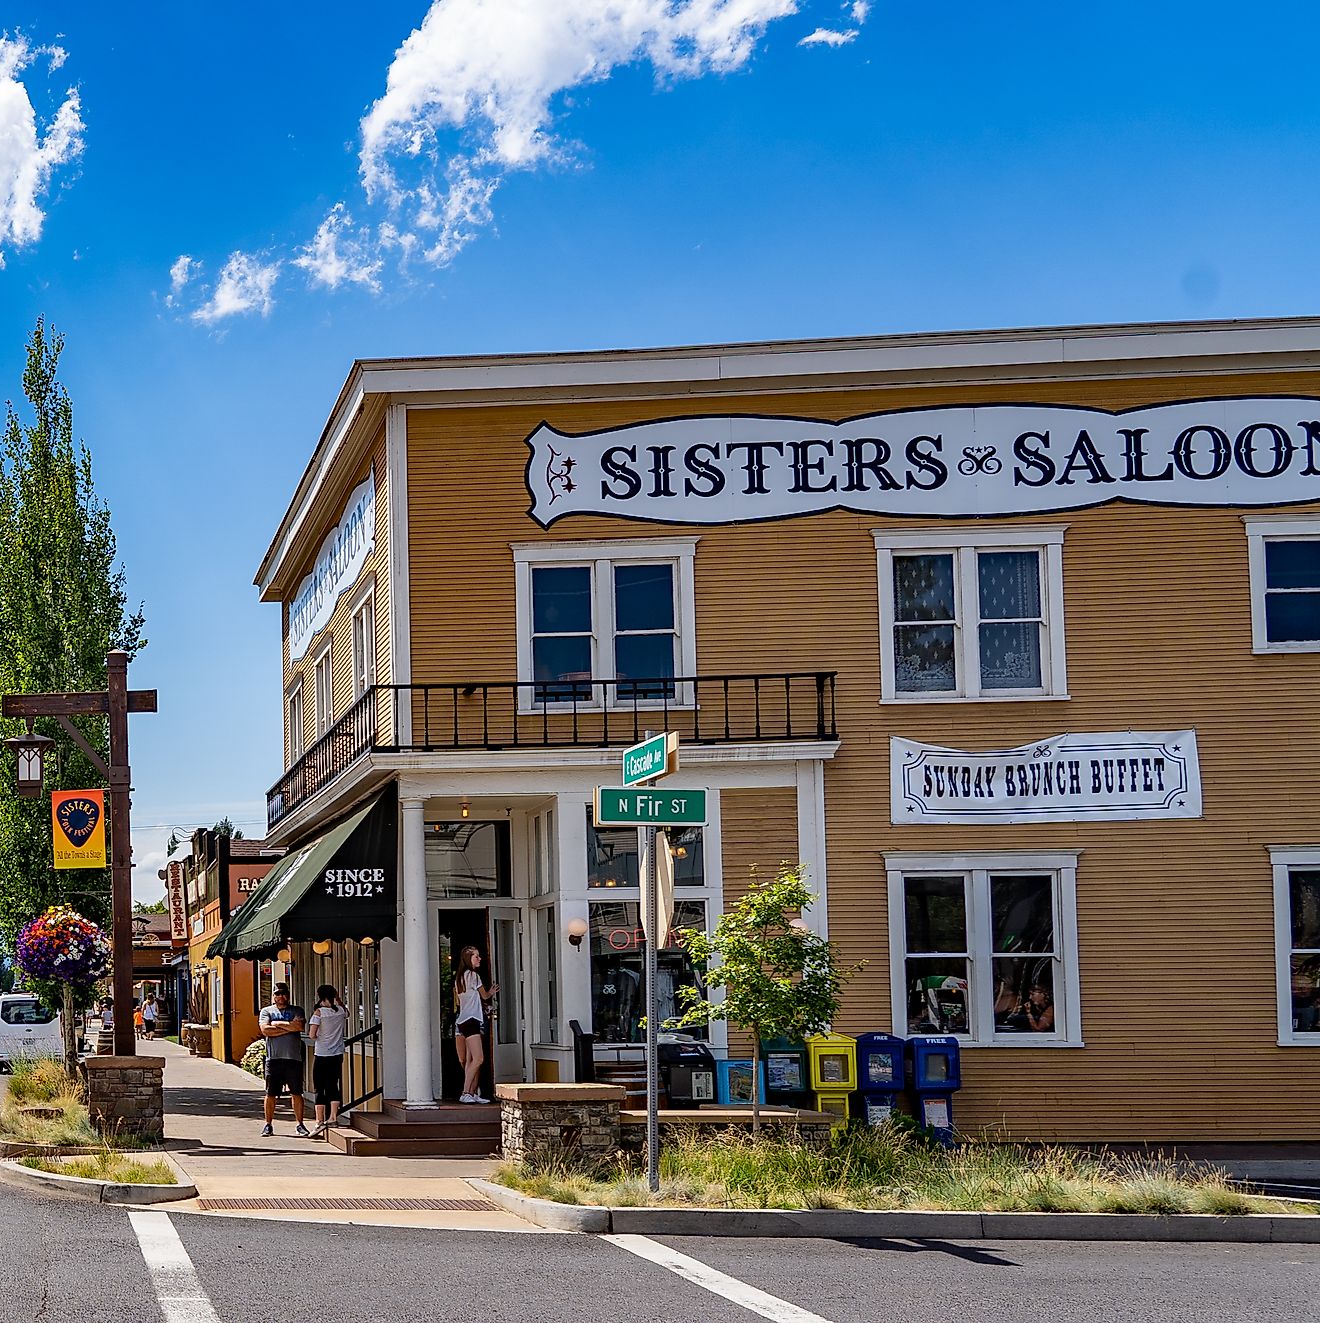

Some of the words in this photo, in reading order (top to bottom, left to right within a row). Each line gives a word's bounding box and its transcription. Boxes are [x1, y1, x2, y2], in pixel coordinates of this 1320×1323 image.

[600, 434, 948, 500] SISTERS
[293, 572, 323, 646] SISTERS
[328, 495, 366, 595] SALOON
[626, 760, 630, 775] E
[630, 750, 653, 776] Cascade
[653, 749, 662, 764] Ave
[923, 764, 996, 798] SUNDAY
[1005, 760, 1081, 798] BRUNCH
[1091, 757, 1165, 793] BUFFET
[61, 801, 95, 817] SISTERS
[619, 798, 628, 812] N
[636, 796, 663, 816] Fir
[671, 799, 687, 814] ST
[61, 818, 74, 834] FOLK
[74, 817, 95, 836] FESTIVAL
[325, 868, 385, 883] SINCE
[170, 863, 184, 936] RESTAURANT
[336, 883, 373, 898] 1912
[609, 928, 685, 950] OPN
